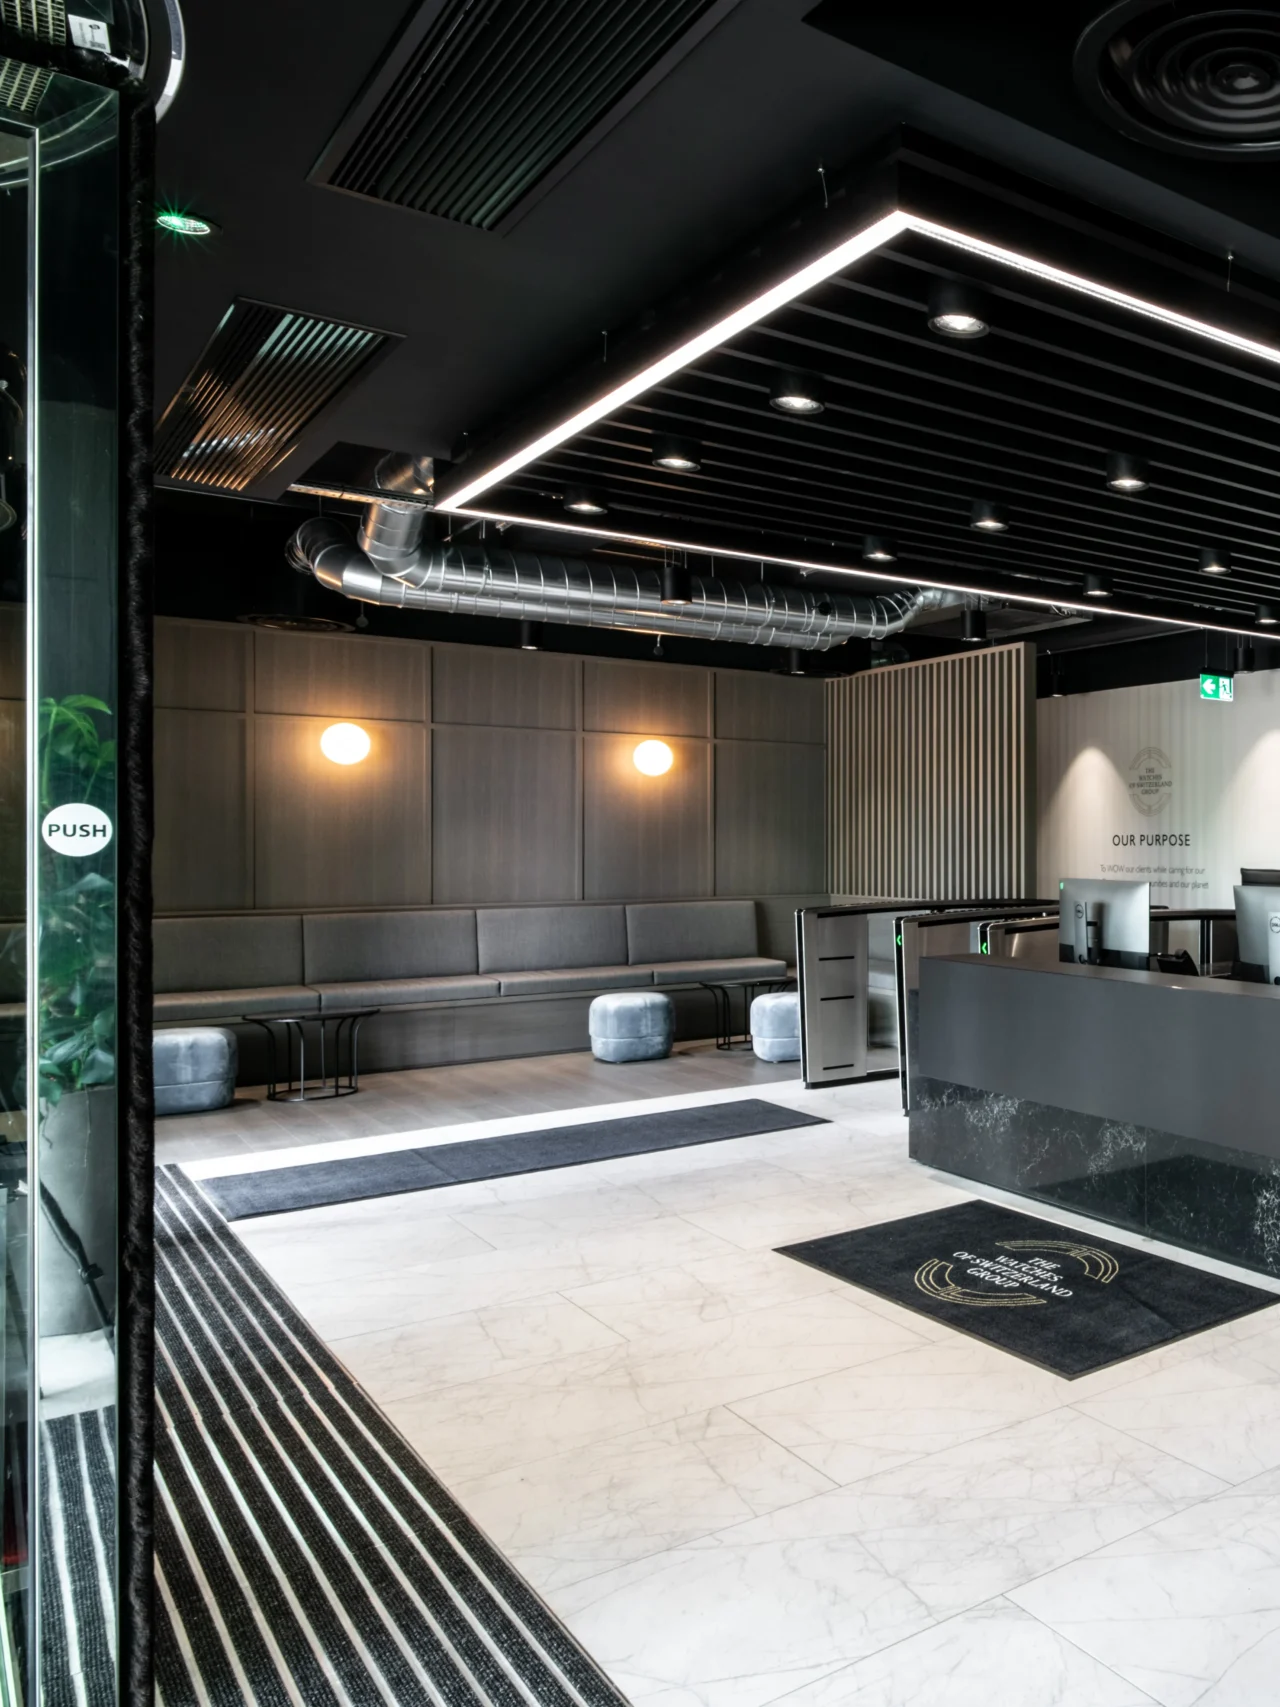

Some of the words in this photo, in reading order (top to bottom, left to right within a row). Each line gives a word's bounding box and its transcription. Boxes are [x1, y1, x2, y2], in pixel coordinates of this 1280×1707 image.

[48, 824, 106, 837] PUSH
[1112, 834, 1136, 847] OUR
[1140, 834, 1191, 847] PURPOSE
[1107, 865, 1125, 873] WOW
[995, 1255, 1063, 1282] WATCHES
[1028, 1257, 1060, 1270] THE
[953, 1251, 977, 1260] OF
[970, 1257, 1073, 1297] SWITZERLAND
[967, 1267, 1019, 1287] GROUP
